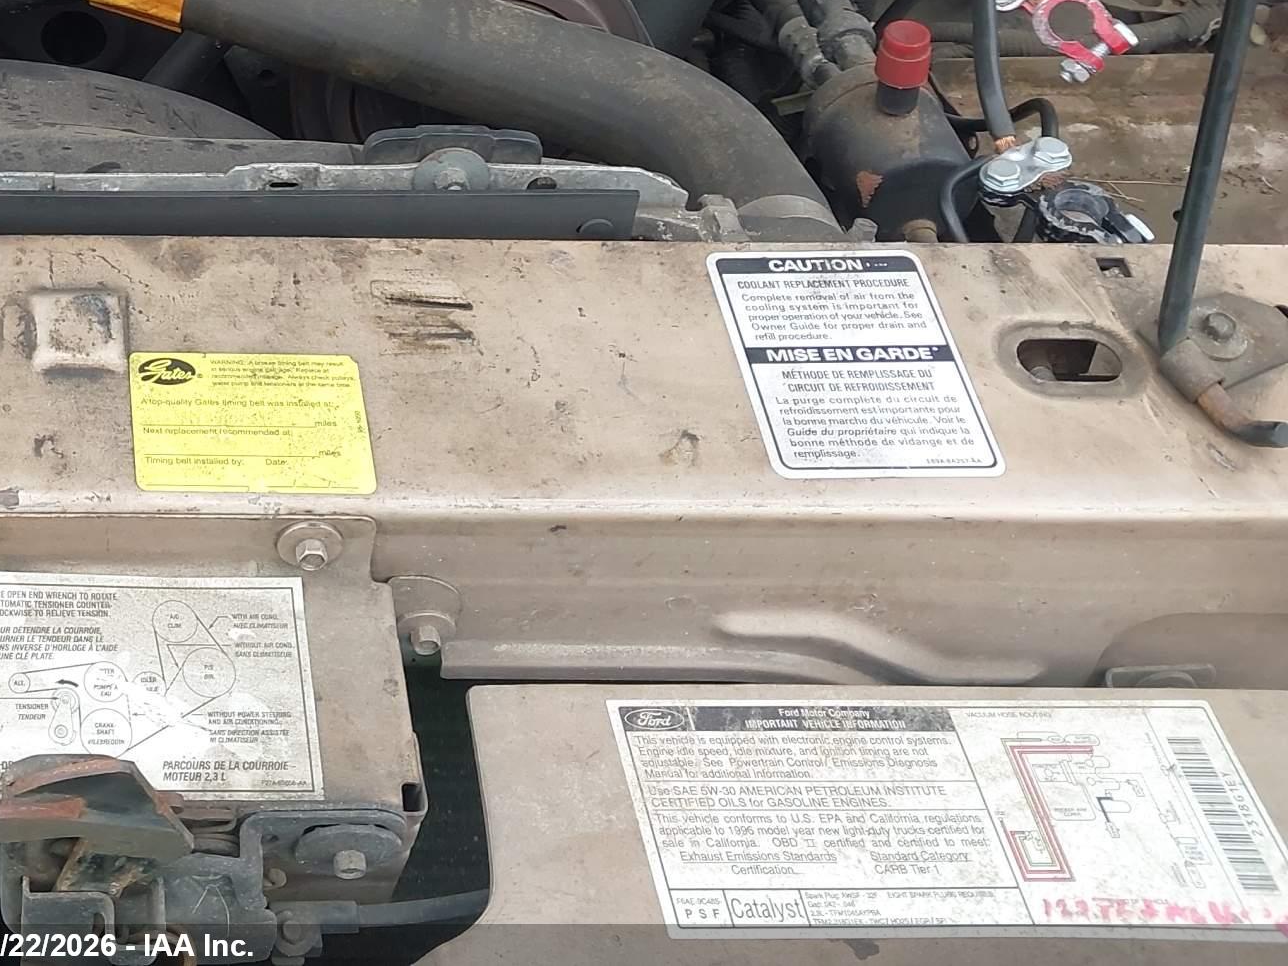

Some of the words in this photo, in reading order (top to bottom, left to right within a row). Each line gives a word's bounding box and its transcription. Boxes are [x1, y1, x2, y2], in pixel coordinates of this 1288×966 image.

[89, 80, 205, 139] FAN
[768, 259, 864, 272] CAUTION
[737, 280, 781, 290] COOLANT
[784, 279, 852, 289] REPLACEMENT
[854, 278, 911, 289] PROCEDURE
[741, 293, 793, 303] Complete
[795, 292, 837, 302] removal
[839, 292, 850, 301] of
[853, 292, 867, 301] air
[869, 291, 895, 301] from
[897, 291, 915, 300] the
[745, 302, 786, 313] cooling
[789, 303, 830, 312] system
[832, 302, 842, 311] is
[844, 302, 901, 313] important
[903, 301, 919, 309] for
[751, 322, 787, 331] Owner
[789, 321, 820, 331] Guide
[823, 321, 839, 330] for
[841, 322, 875, 332] proper
[878, 320, 904, 329] drain
[907, 319, 927, 329] and
[754, 332, 776, 341] refill
[778, 331, 833, 342] procedure.
[766, 348, 822, 363] MISE
[822, 347, 854, 362] EN
[139, 359, 196, 383] Gates
[782, 368, 830, 380] MÉTHODE
[831, 370, 845, 380] DE
[847, 369, 916, 379] REMPLISSAGE
[918, 369, 932, 378] DU
[788, 382, 826, 393] CIRCUIT
[829, 382, 843, 392] DE
[844, 381, 936, 392] REFROIDISSEMENT
[140, 397, 149, 406] A
[149, 398, 193, 407] top-quality
[195, 398, 220, 407] Gates
[222, 399, 247, 408] timing
[249, 398, 265, 407] belt
[266, 400, 285, 408] was
[286, 399, 321, 408] installed
[322, 400, 335, 408] at:
[318, 449, 342, 457] miles
[145, 456, 174, 466] Timing
[176, 457, 192, 465] belt
[193, 457, 230, 466] installed
[231, 458, 245, 467] by:
[265, 458, 288, 466] Date:
[7, 591, 27, 599] OPEN
[28, 591, 44, 599] END
[45, 591, 77, 600] WRENCH
[79, 592, 89, 600] TO
[34, 600, 74, 609] TENSIONER
[34, 609, 44, 617] TO
[45, 609, 75, 617] RELIEVE
[637, 710, 673, 727] Ford
[778, 708, 800, 718] Ford
[801, 709, 827, 718] Motor
[828, 709, 870, 719] Company
[745, 719, 799, 729] IMPORTANT
[802, 719, 841, 729] VEHICLE
[842, 719, 906, 729] INFORMATION
[162, 760, 211, 771] PARCOURS
[214, 761, 226, 771] DE
[228, 761, 240, 771] LA
[242, 761, 289, 771] COURROIE
[162, 771, 202, 782] MOTEUR
[204, 771, 218, 783] 2,3
[221, 772, 227, 782] L
[648, 786, 670, 796] Use
[672, 785, 699, 796] SAE
[700, 786, 737, 796] 5W-30
[739, 786, 803, 796] AMERICAN
[806, 786, 882, 796] PETROLEUM
[884, 786, 948, 796] INSTITUTE
[651, 798, 716, 808] CERTIFIED
[718, 798, 748, 808] OILS
[748, 798, 765, 808] for
[766, 798, 829, 808] GASOLINE
[833, 798, 892, 808] ENGINES.
[680, 851, 723, 862] Exhaust
[726, 851, 781, 862] Emissions
[782, 850, 838, 862] Standards
[870, 850, 919, 862] Standard
[920, 850, 969, 862] Category
[731, 864, 794, 875] Certification
[874, 864, 908, 875] CARB
[911, 864, 931, 875] Tier
[933, 864, 940, 875] 1
[730, 897, 806, 923] Catalyst
